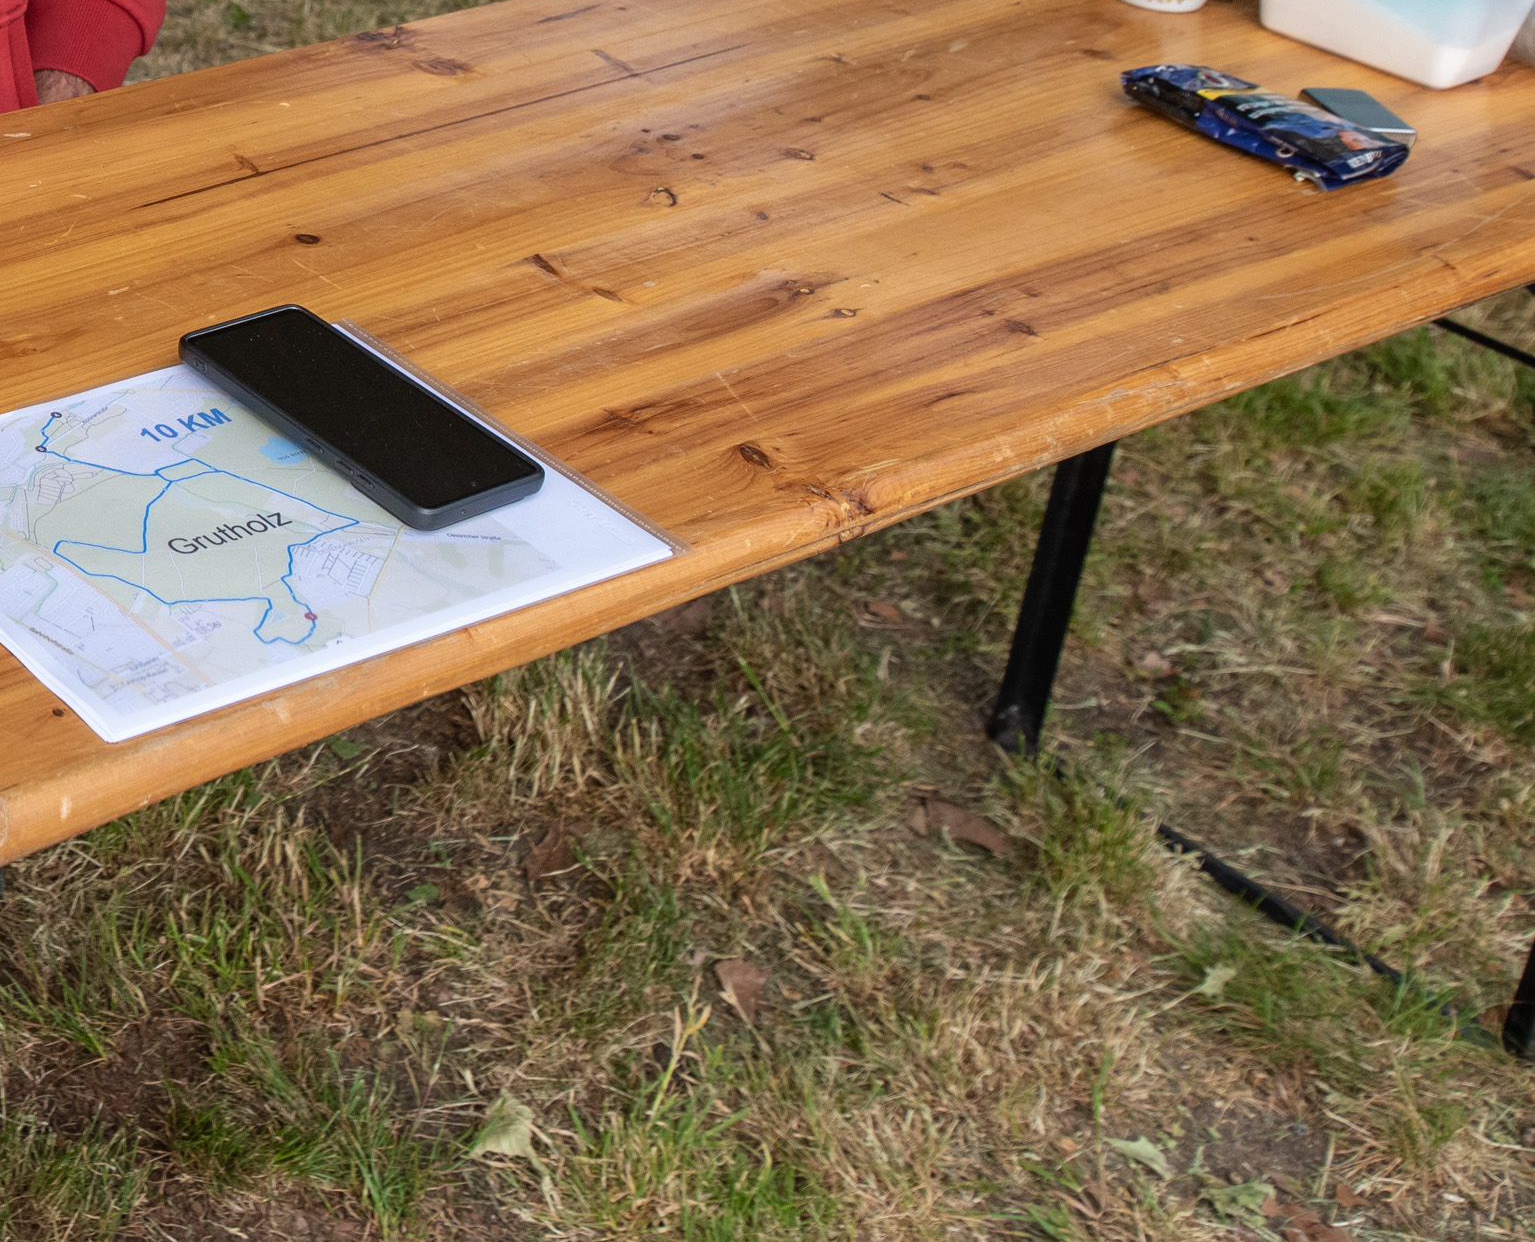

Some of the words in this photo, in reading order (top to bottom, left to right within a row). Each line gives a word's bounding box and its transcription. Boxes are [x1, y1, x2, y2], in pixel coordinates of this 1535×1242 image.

[140, 423, 178, 442] 10
[177, 408, 232, 433] KM
[167, 511, 292, 555] Grutholz
